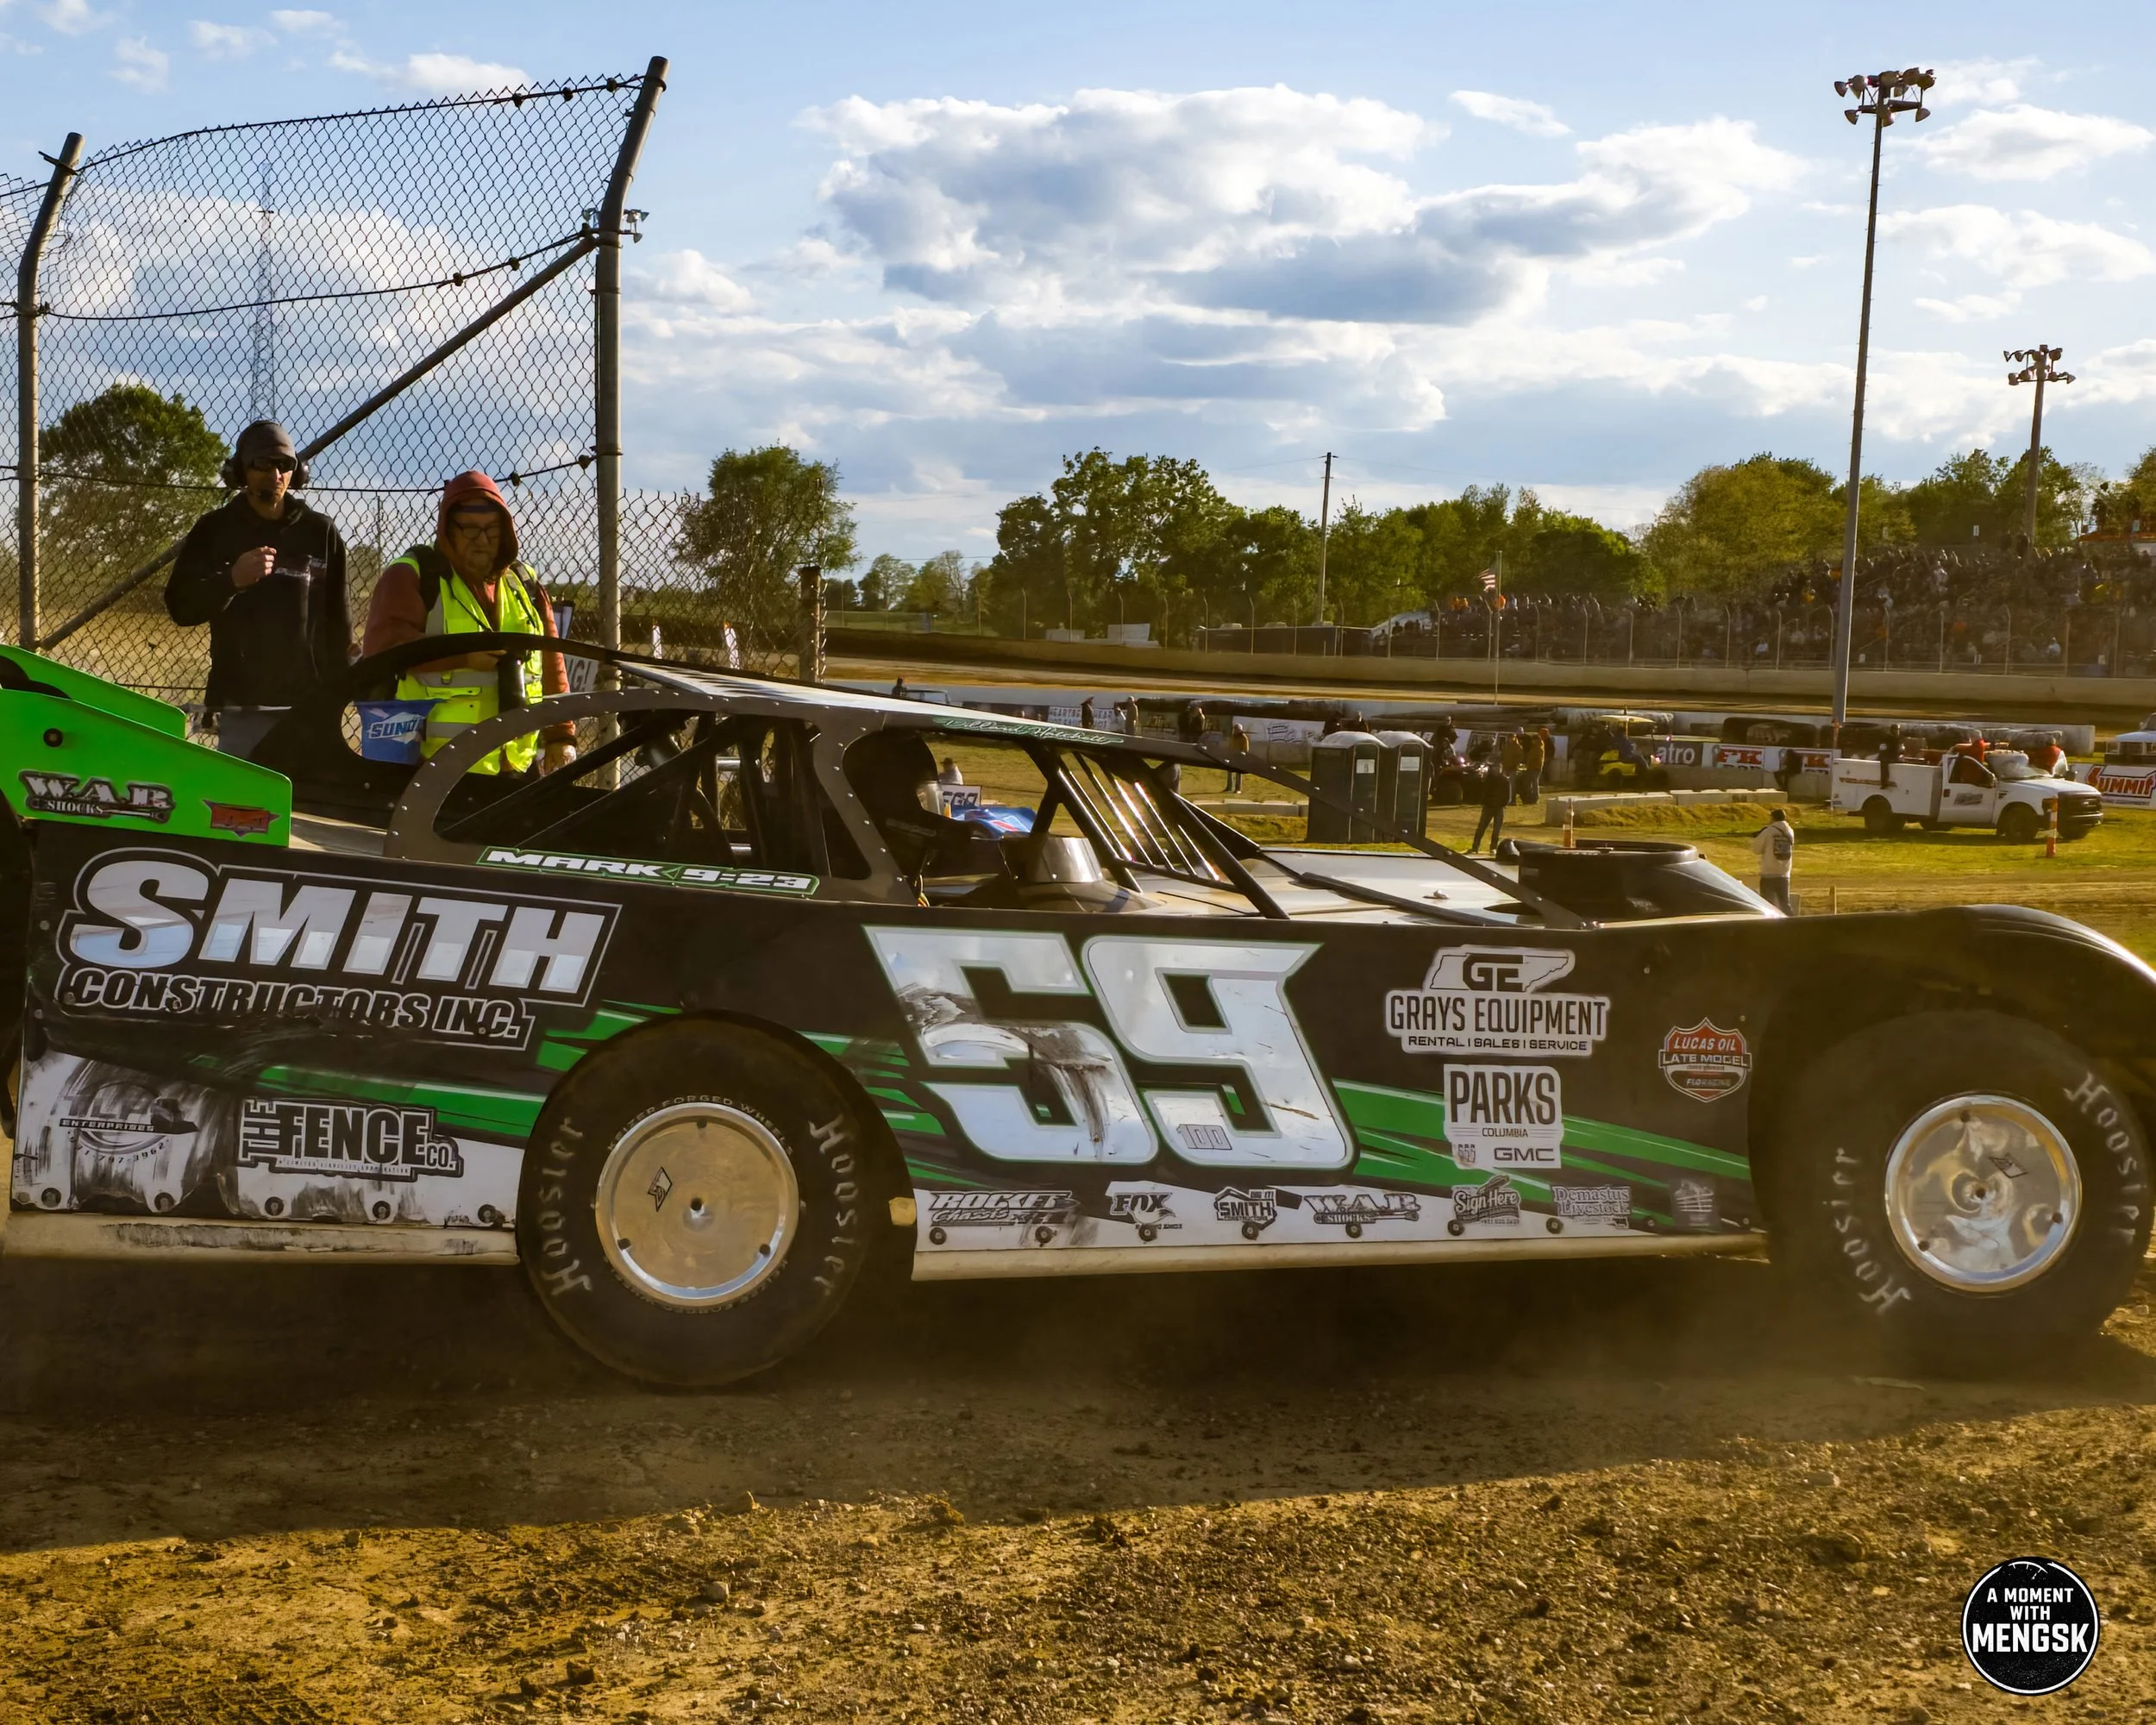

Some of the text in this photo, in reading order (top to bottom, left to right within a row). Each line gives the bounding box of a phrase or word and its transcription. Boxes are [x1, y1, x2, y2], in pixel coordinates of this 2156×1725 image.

[47, 800, 104, 814] SHOCKS
[486, 850, 812, 889] MARK 9:23
[69, 860, 605, 994] SMITH
[1463, 953, 1523, 992] GE
[69, 967, 524, 1038] CONSTRUCTORS INC.
[1390, 994, 1606, 1036] GRAYS EQUIPMENT
[863, 925, 1352, 1169] 59
[1408, 1036, 1588, 1051] RENTAL SALES SERVICE
[1673, 1038, 1737, 1051] LUCAS OIL
[1662, 1052, 1747, 1067] LATE MODEL
[662, 1095, 734, 1107] FORGED
[1450, 1070, 1556, 1125] PARKS
[61, 1120, 154, 1132] ENTERPRISES
[239, 1099, 279, 1162] THE
[1482, 1127, 1529, 1138] COLUMBIA
[278, 1105, 458, 1170] FENCE CO.
[1494, 1148, 1555, 1161] GMC
[929, 1192, 1072, 1210] ROCKET
[1454, 1187, 1518, 1216] Sign Here
[1553, 1187, 1630, 1202] Demastus
[1115, 1194, 1169, 1213] FOX
[1219, 1201, 1273, 1217] SMITH
[1559, 1201, 1631, 1215] Livestock
[931, 1209, 1009, 1223] Chassis
